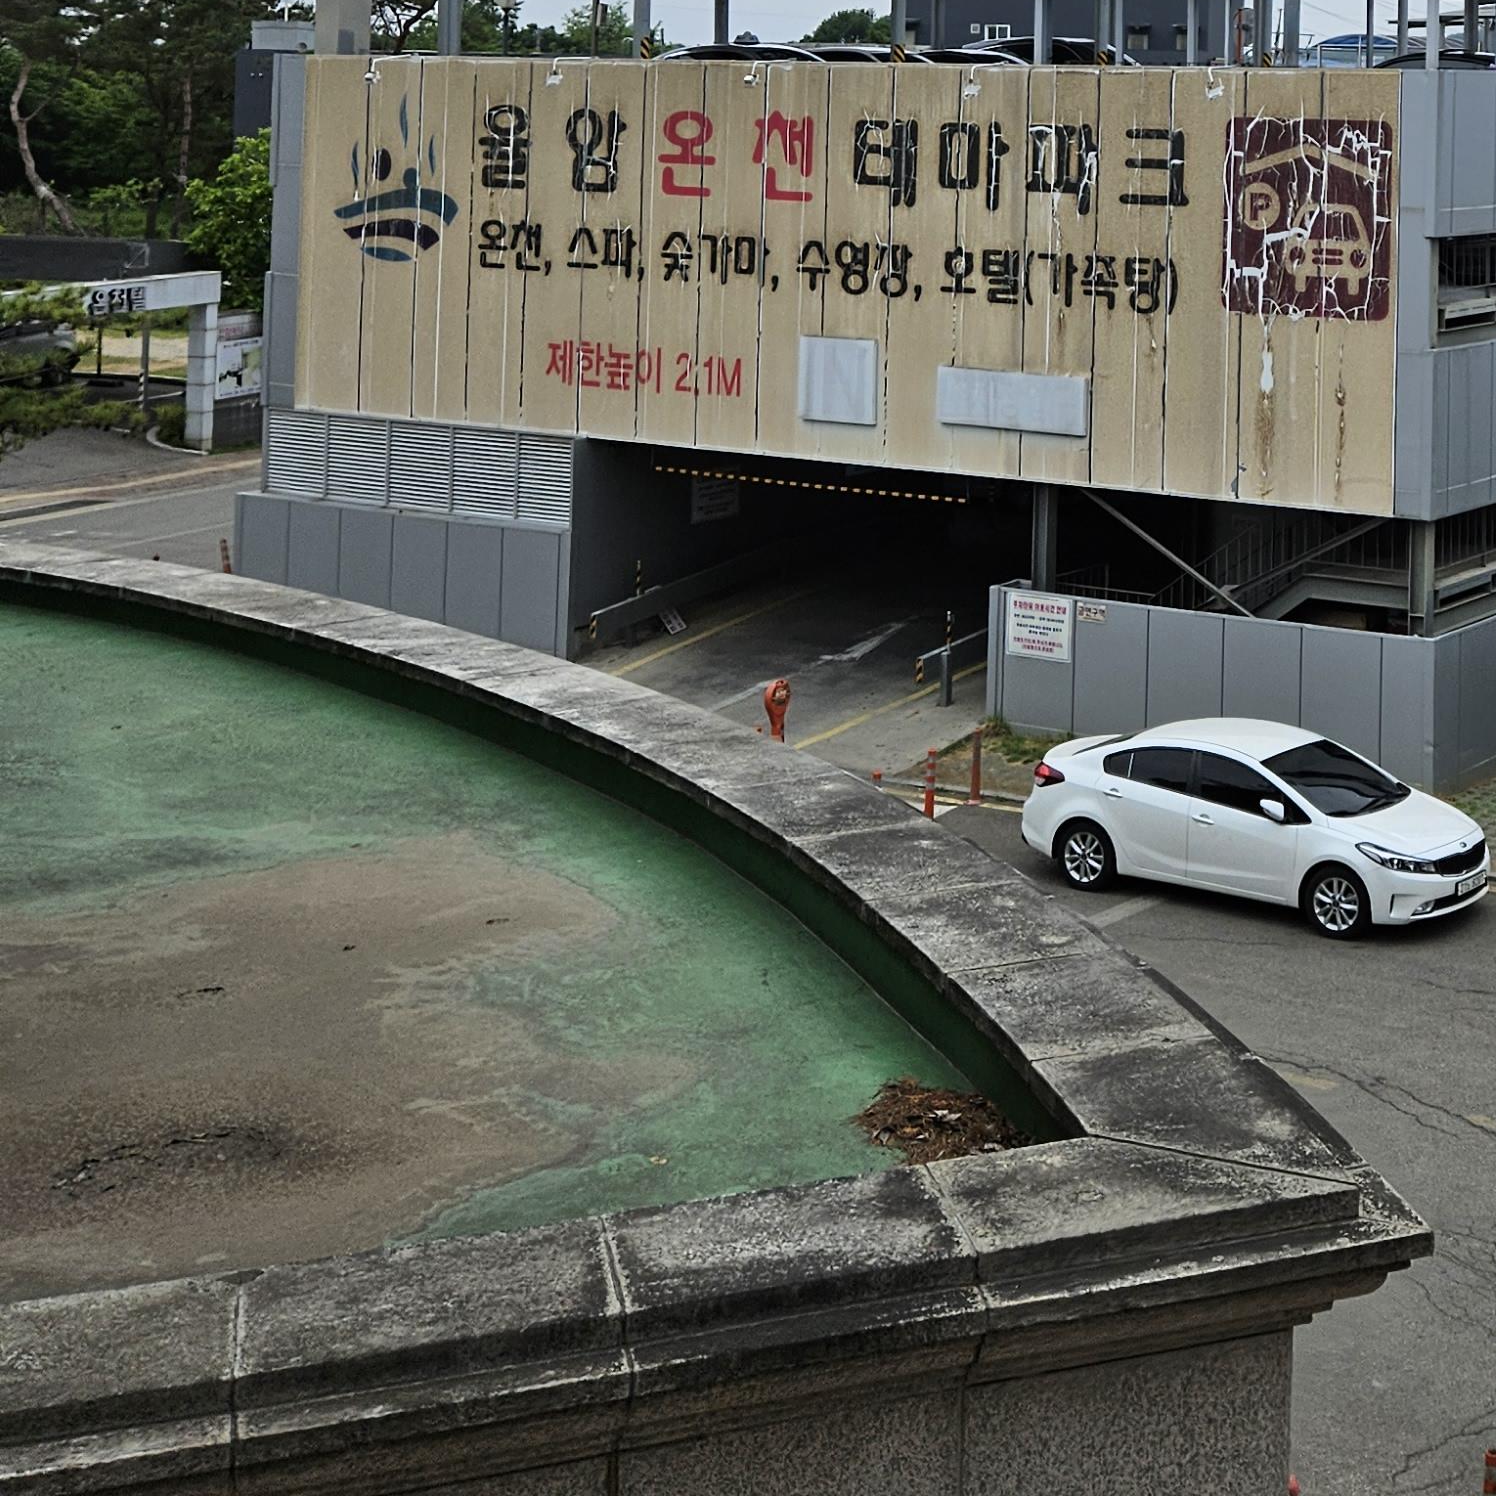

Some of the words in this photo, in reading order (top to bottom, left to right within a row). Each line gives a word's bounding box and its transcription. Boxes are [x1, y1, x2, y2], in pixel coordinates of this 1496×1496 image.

[854, 118, 1189, 215] 테마파크
[1250, 193, 1272, 221] P
[545, 339, 662, 395] 제한높이
[675, 353, 742, 397] 2.1M
